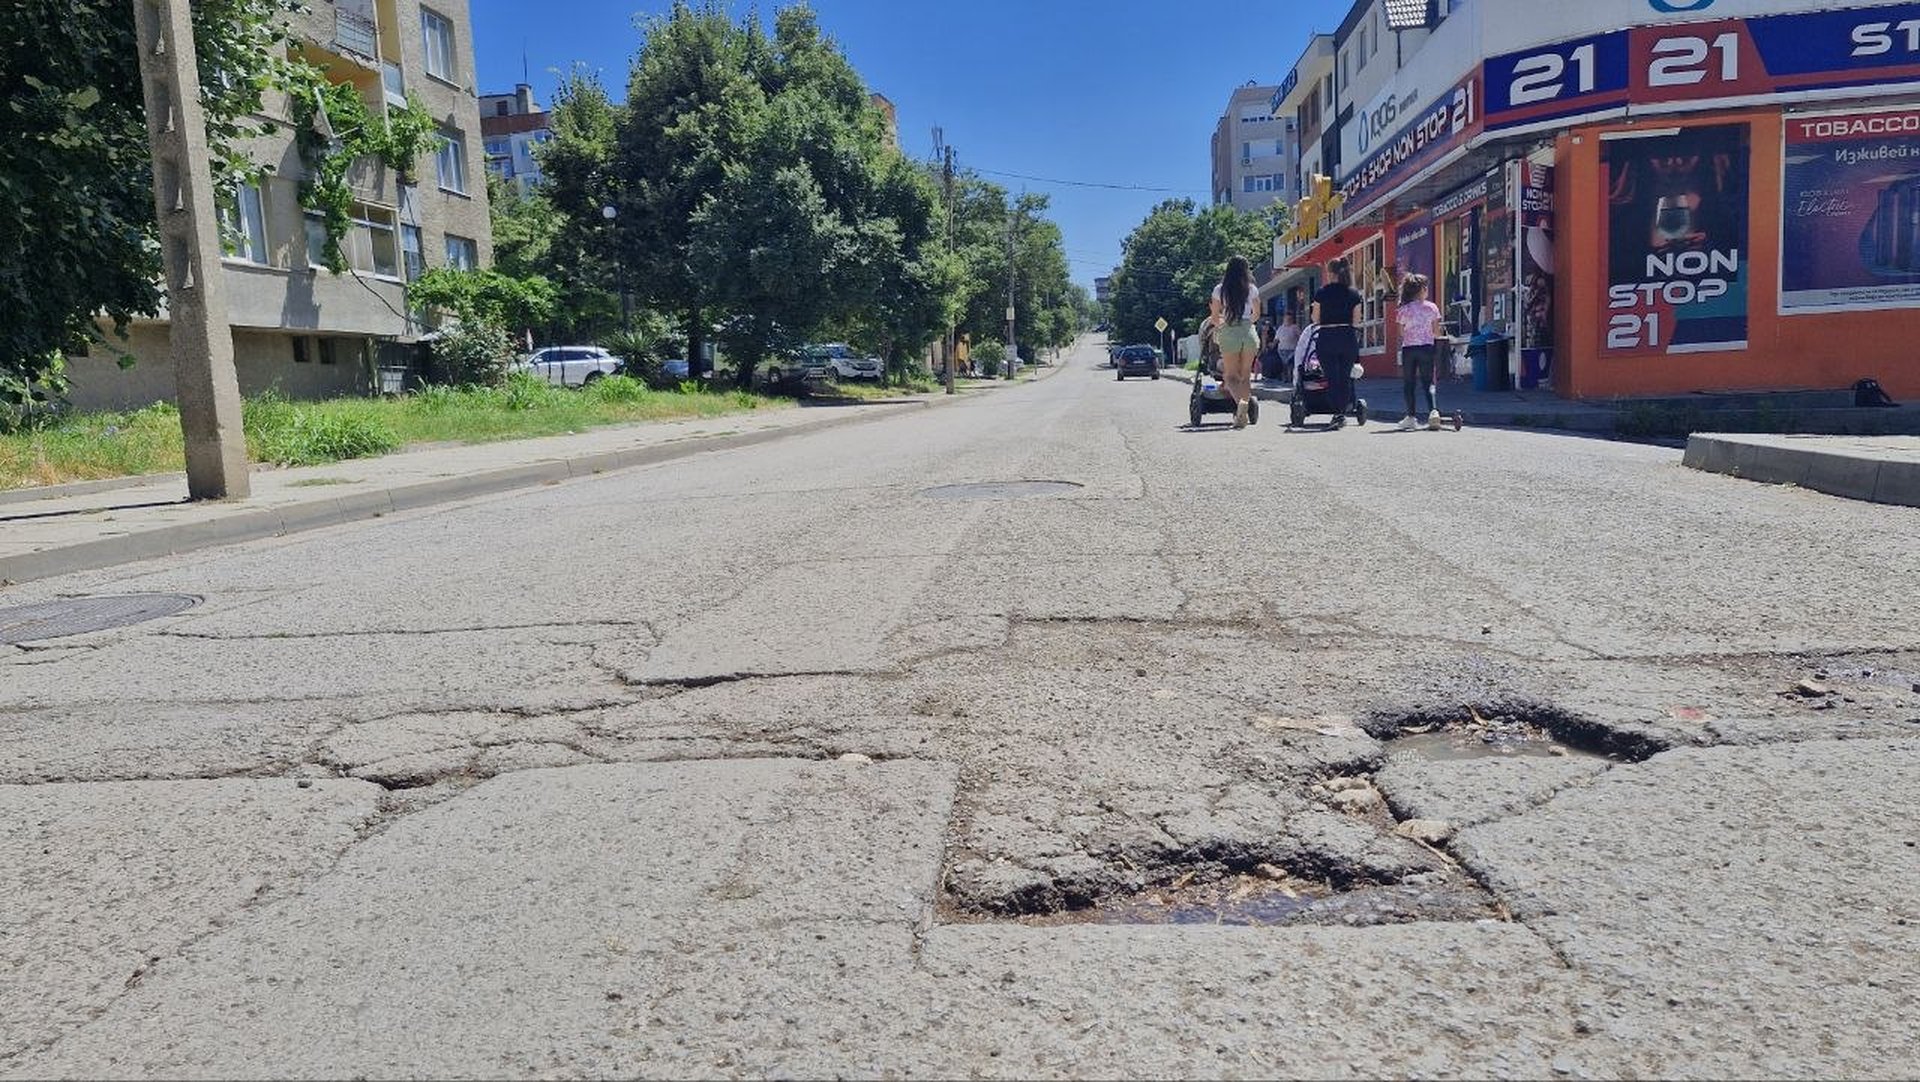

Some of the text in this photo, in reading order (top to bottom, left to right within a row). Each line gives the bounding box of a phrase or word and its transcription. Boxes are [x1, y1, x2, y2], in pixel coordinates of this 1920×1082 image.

[1648, 32, 1738, 86] 21
[1509, 43, 1594, 106] 21
[1368, 148, 1392, 183] SHOP
[1393, 130, 1415, 163] NON
[1416, 105, 1447, 150] STOP
[1452, 79, 1474, 134] 21
[1800, 116, 1920, 138] TOBACCO
[1835, 145, 1907, 165] Изживей
[1526, 188, 1543, 200] NON
[1646, 248, 1738, 277] NON
[1493, 293, 1506, 320] 21
[1608, 278, 1728, 309] STOP
[1607, 312, 1659, 349] 21
